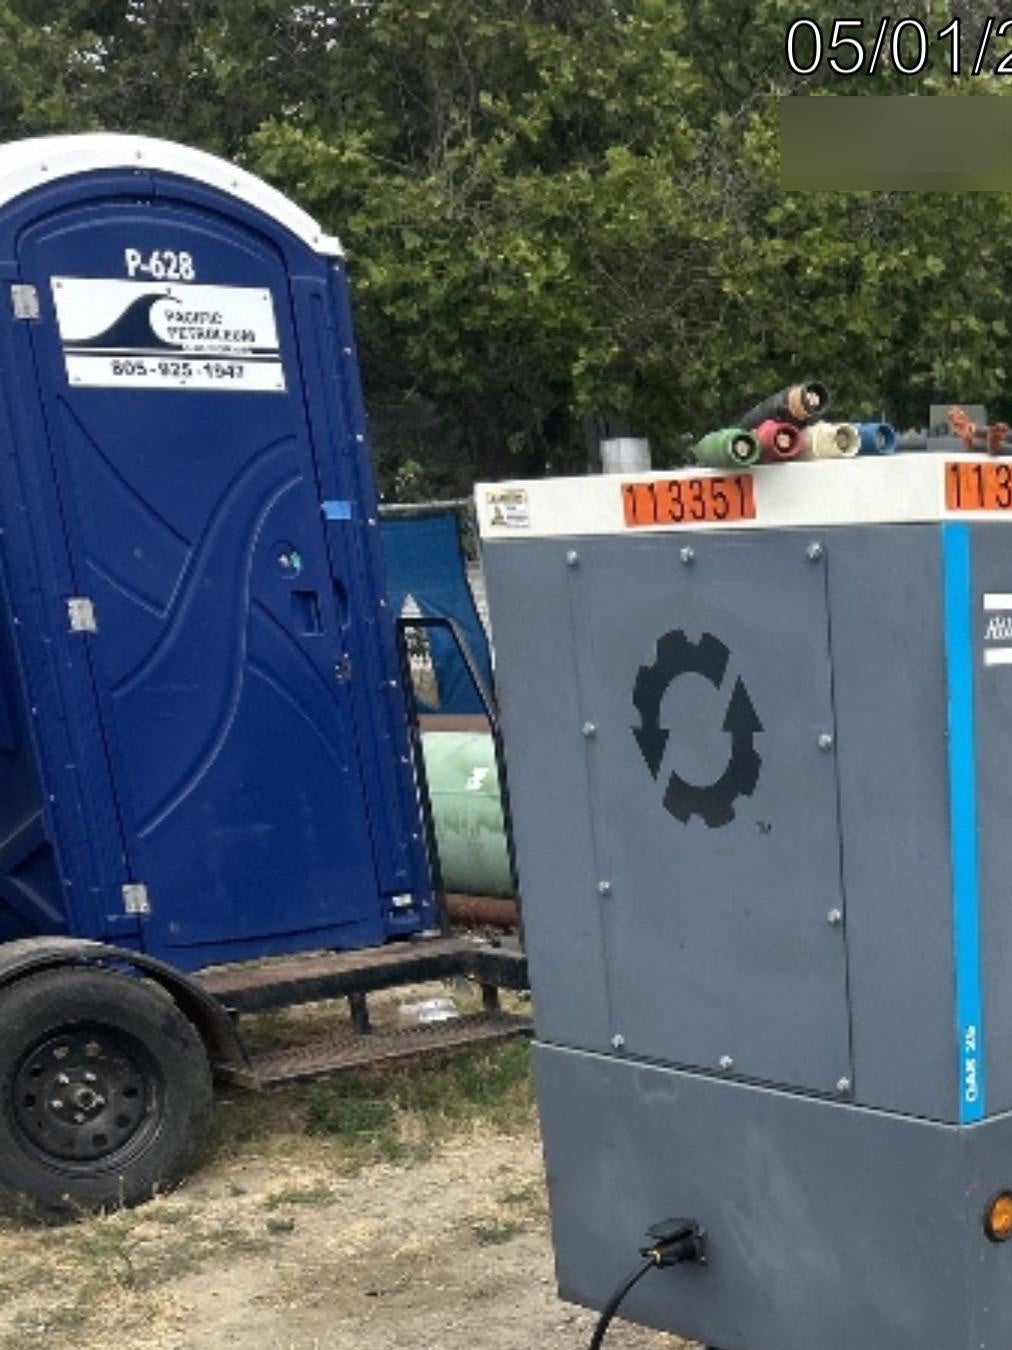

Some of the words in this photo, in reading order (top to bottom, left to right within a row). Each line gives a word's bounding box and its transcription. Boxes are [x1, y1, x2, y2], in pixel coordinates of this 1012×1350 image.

[125, 248, 195, 280] P-628
[164, 309, 223, 325] PACIFIC
[626, 475, 745, 522] 113351
